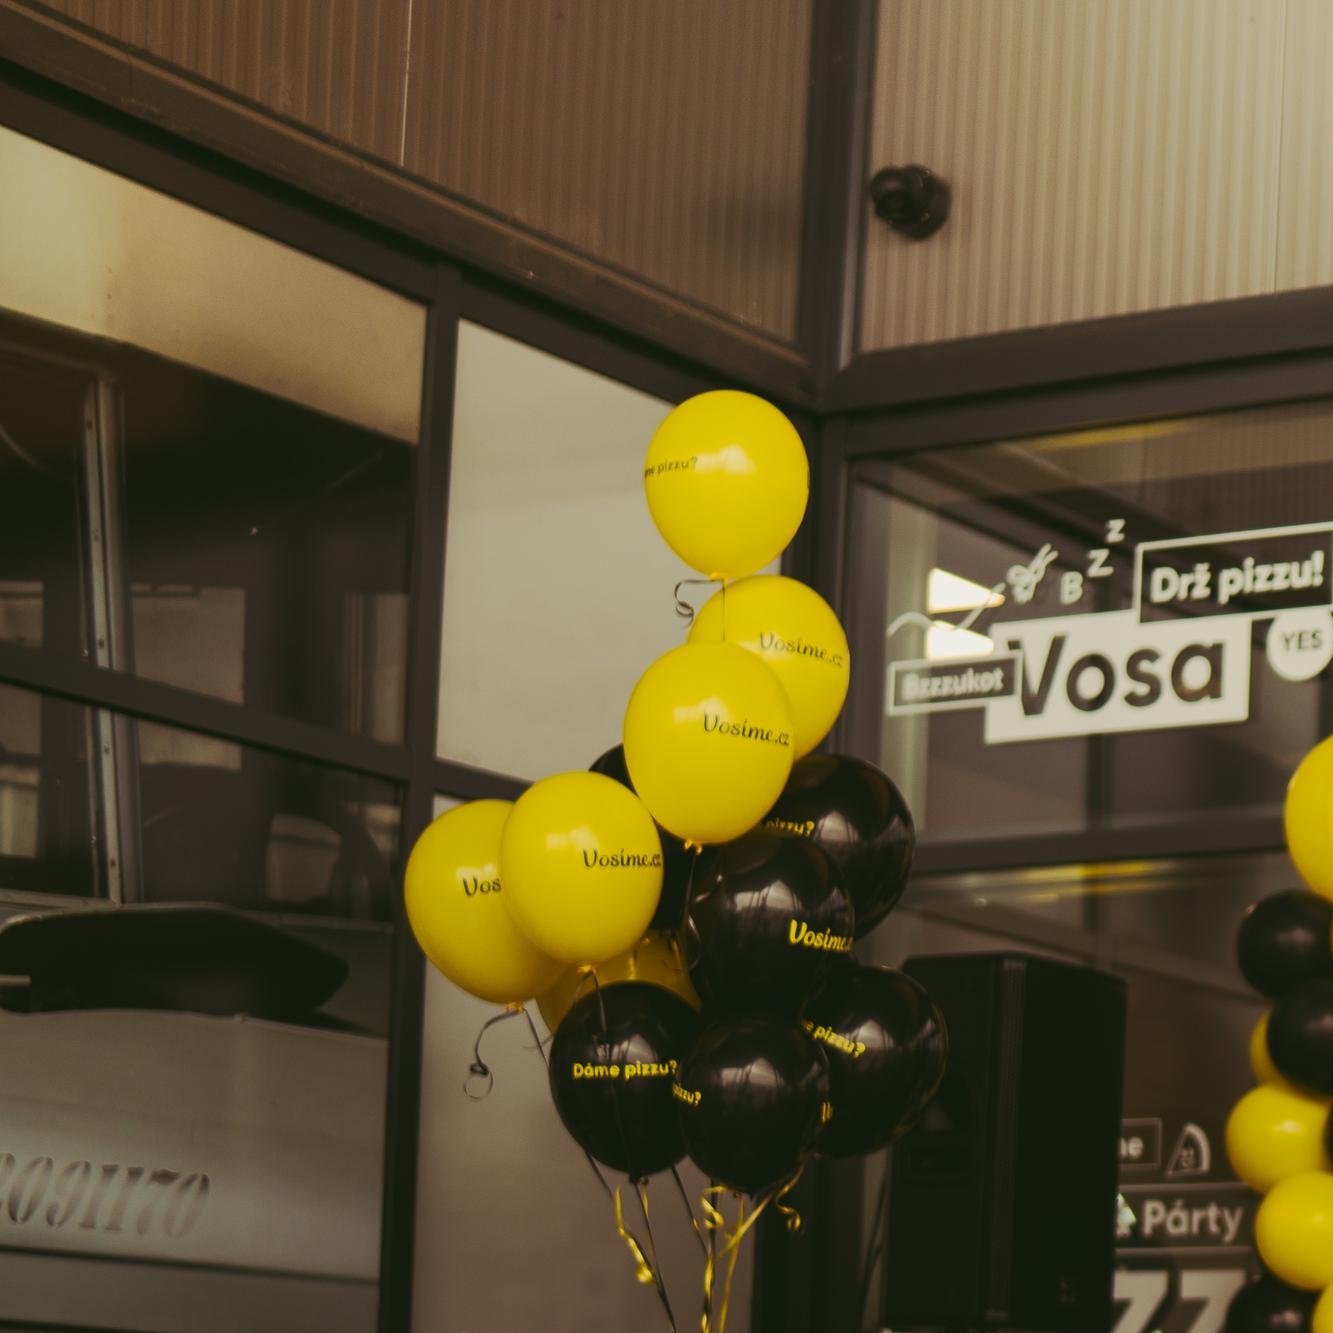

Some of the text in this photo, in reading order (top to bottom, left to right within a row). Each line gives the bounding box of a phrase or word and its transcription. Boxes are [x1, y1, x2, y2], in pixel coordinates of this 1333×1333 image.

[1150, 550, 1324, 605] Drž pizzu!
[1280, 626, 1324, 652] YES
[1007, 635, 1226, 716] Vosa
[573, 1060, 677, 1081] Dáme pizzu?
[1143, 1199, 1244, 1243] Párty
